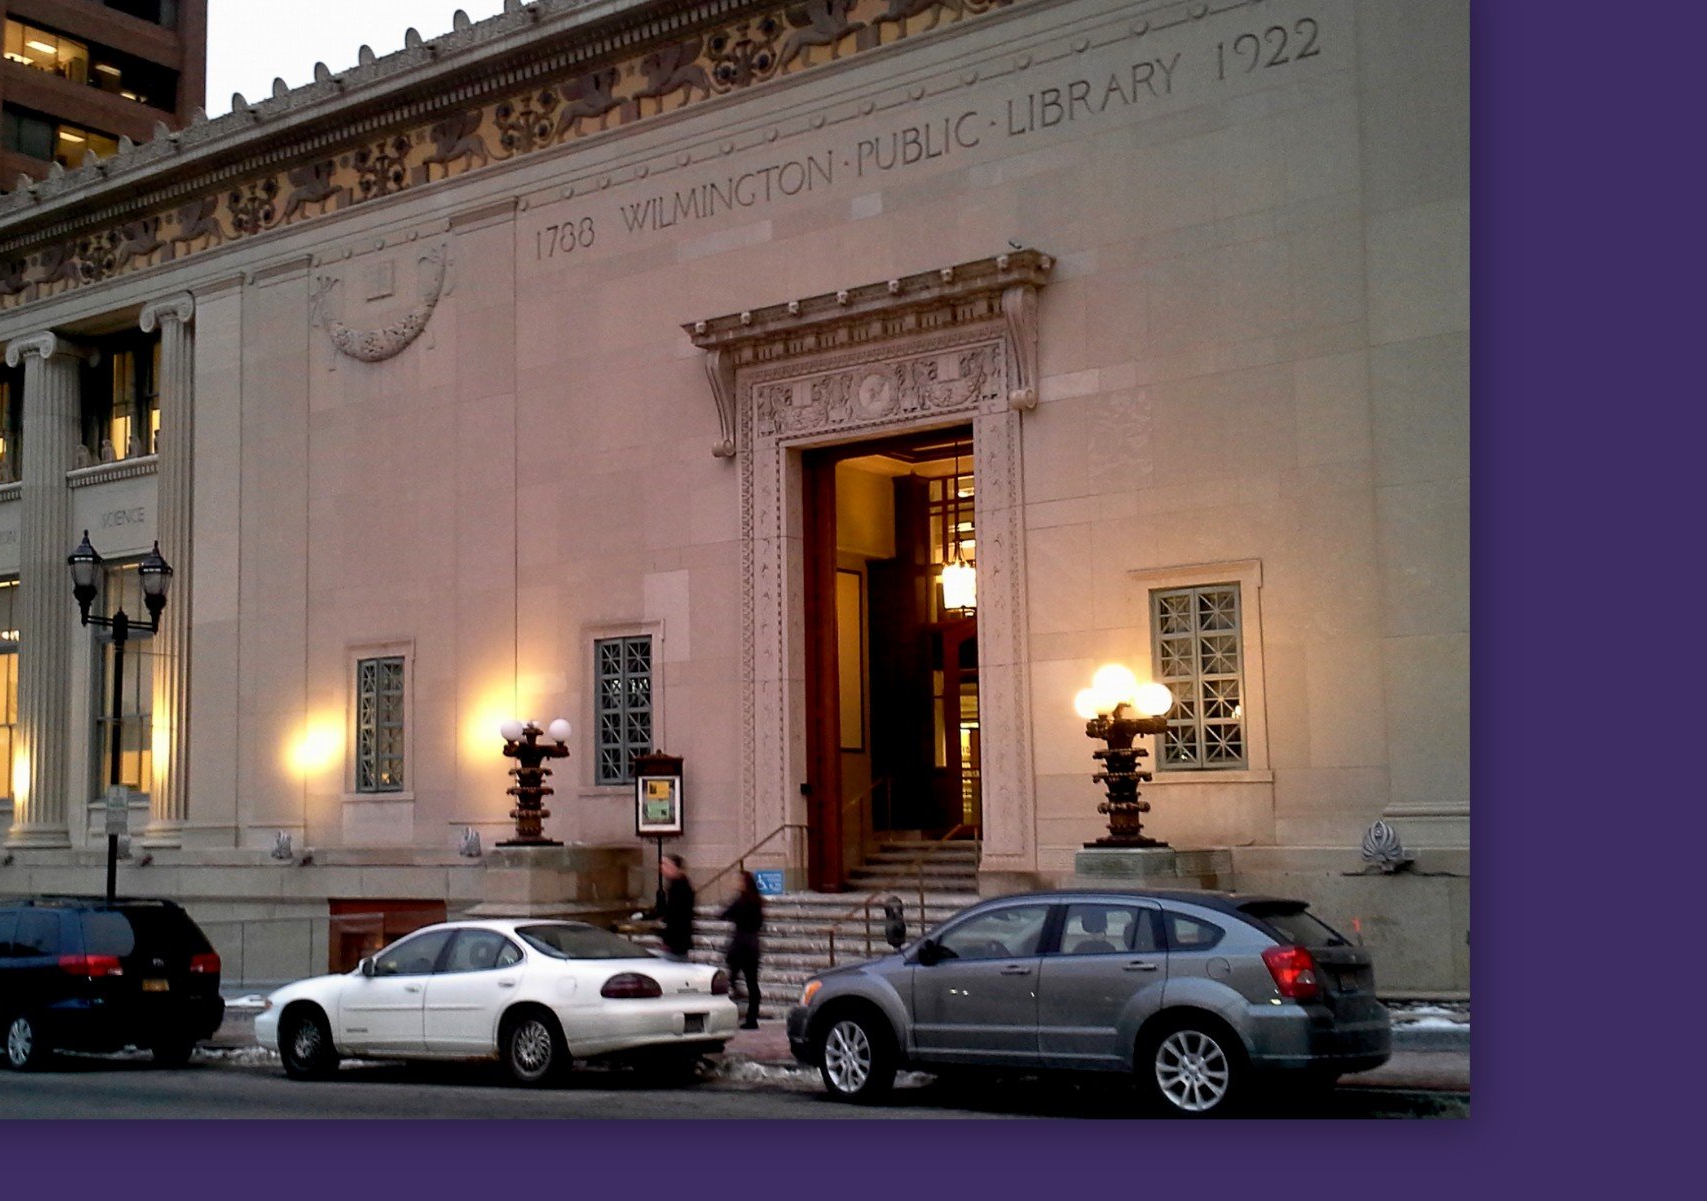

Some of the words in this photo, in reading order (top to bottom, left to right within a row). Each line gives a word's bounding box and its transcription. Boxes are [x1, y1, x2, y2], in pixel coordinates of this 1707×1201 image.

[536, 216, 596, 261] 1788
[620, 150, 834, 233] WILMINGTON
[856, 111, 981, 177] PUBLIC
[1007, 53, 1182, 137] LIBRARY
[1216, 16, 1322, 81] 1922
